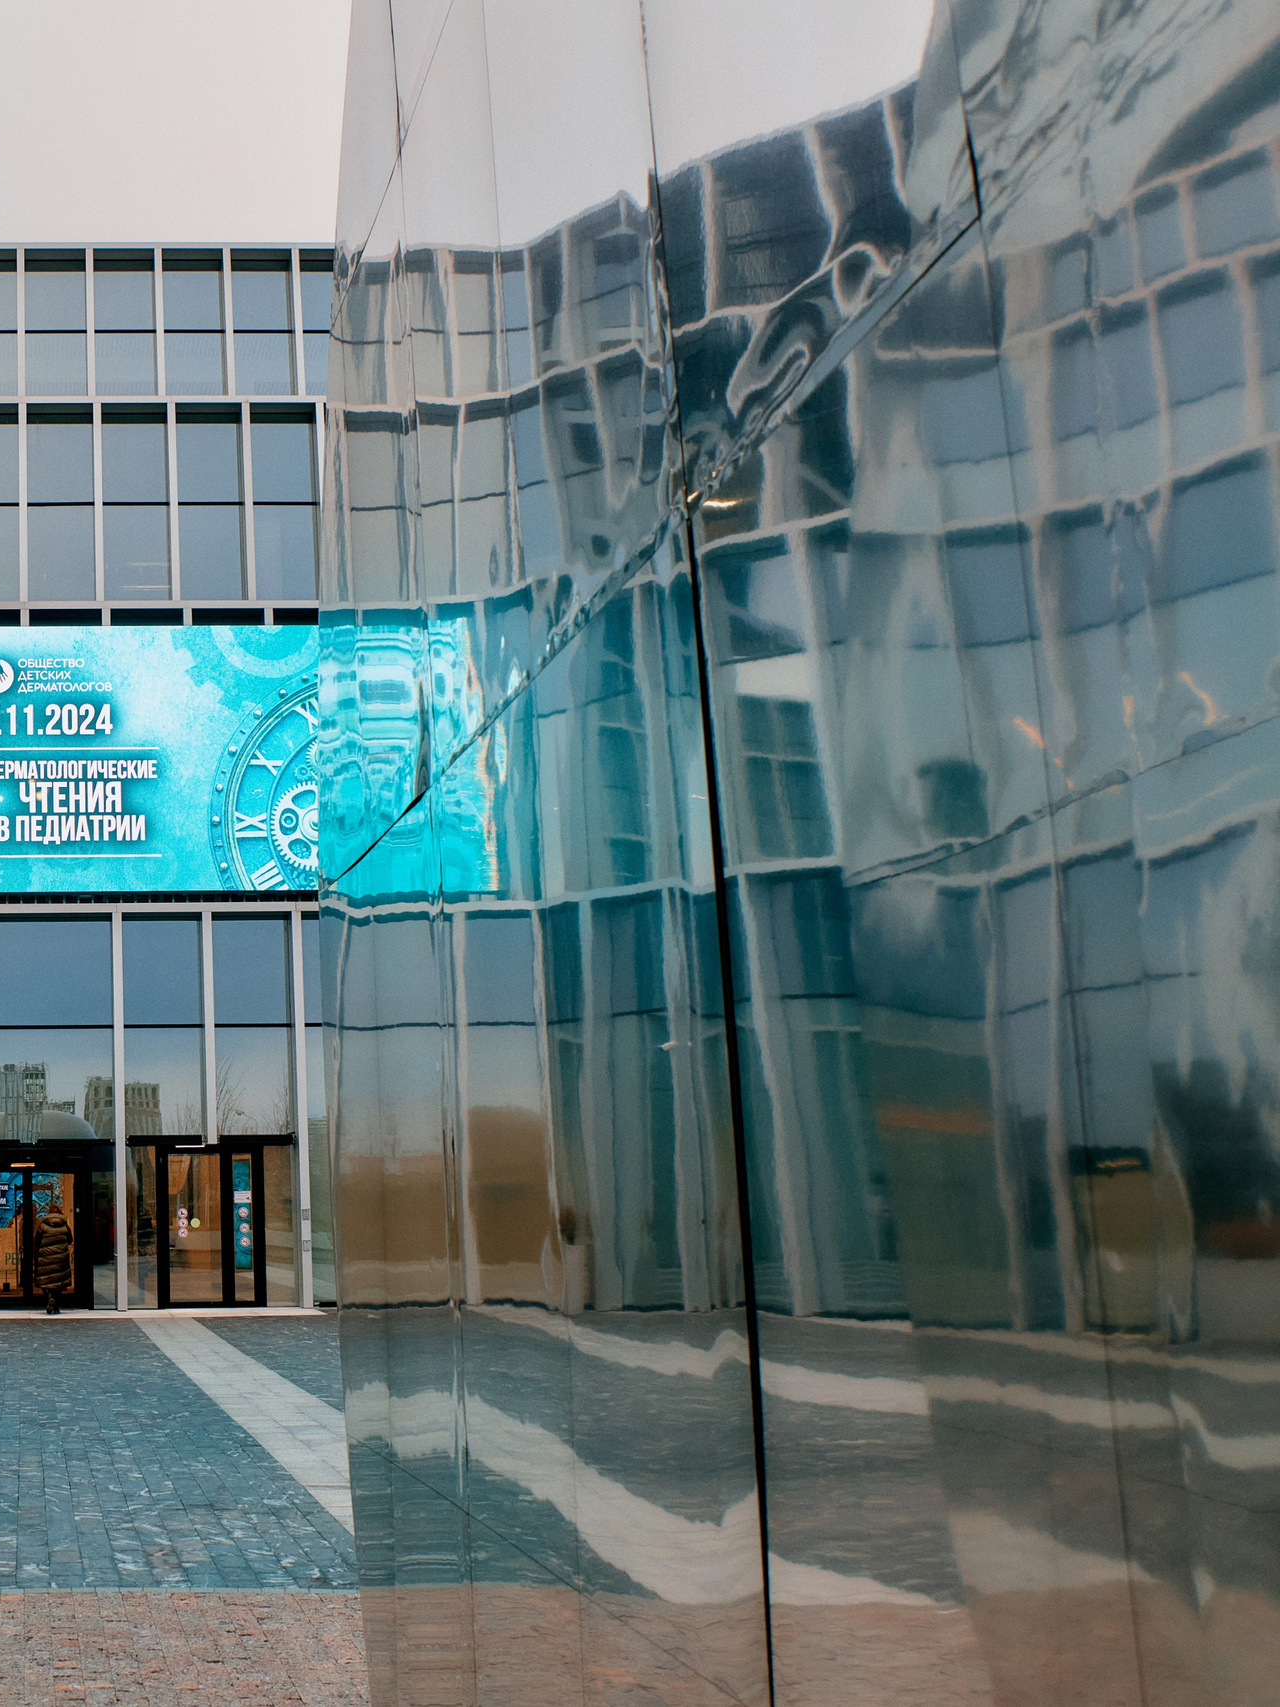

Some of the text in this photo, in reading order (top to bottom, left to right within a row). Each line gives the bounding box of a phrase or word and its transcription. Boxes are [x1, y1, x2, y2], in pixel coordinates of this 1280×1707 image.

[17, 658, 85, 669] ОБЩЕСТВО
[17, 670, 72, 681] ДЕТСКИХ
[17, 682, 113, 693] ДЕРМАТОЛОГОВ
[19, 781, 122, 814] ЧТЕНИЯ
[15, 815, 146, 845] ПЕДИАТРИИ
